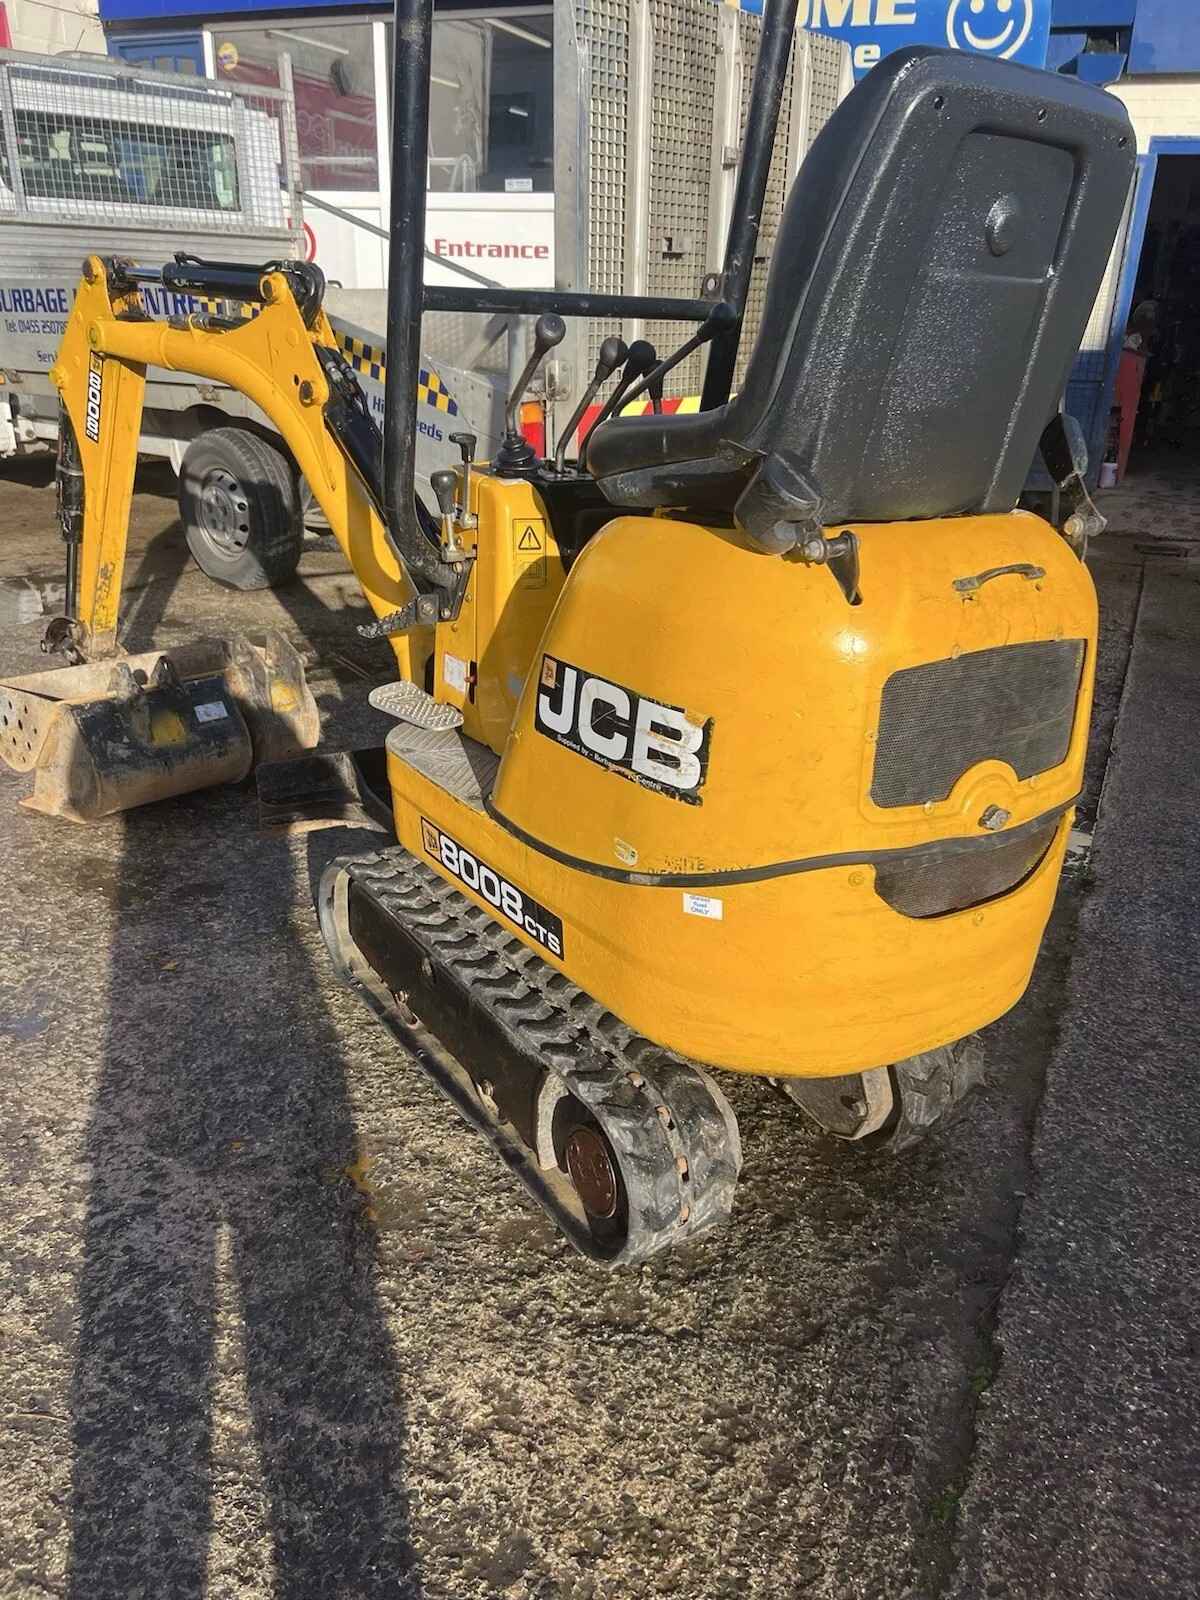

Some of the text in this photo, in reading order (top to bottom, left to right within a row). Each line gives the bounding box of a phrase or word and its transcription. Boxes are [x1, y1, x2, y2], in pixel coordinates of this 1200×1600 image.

[433, 238, 550, 260] Entrance
[0, 287, 69, 314] URBAGE
[416, 420, 443, 442] eds
[538, 666, 704, 790] JCB
[690, 906, 710, 916] ONLY
